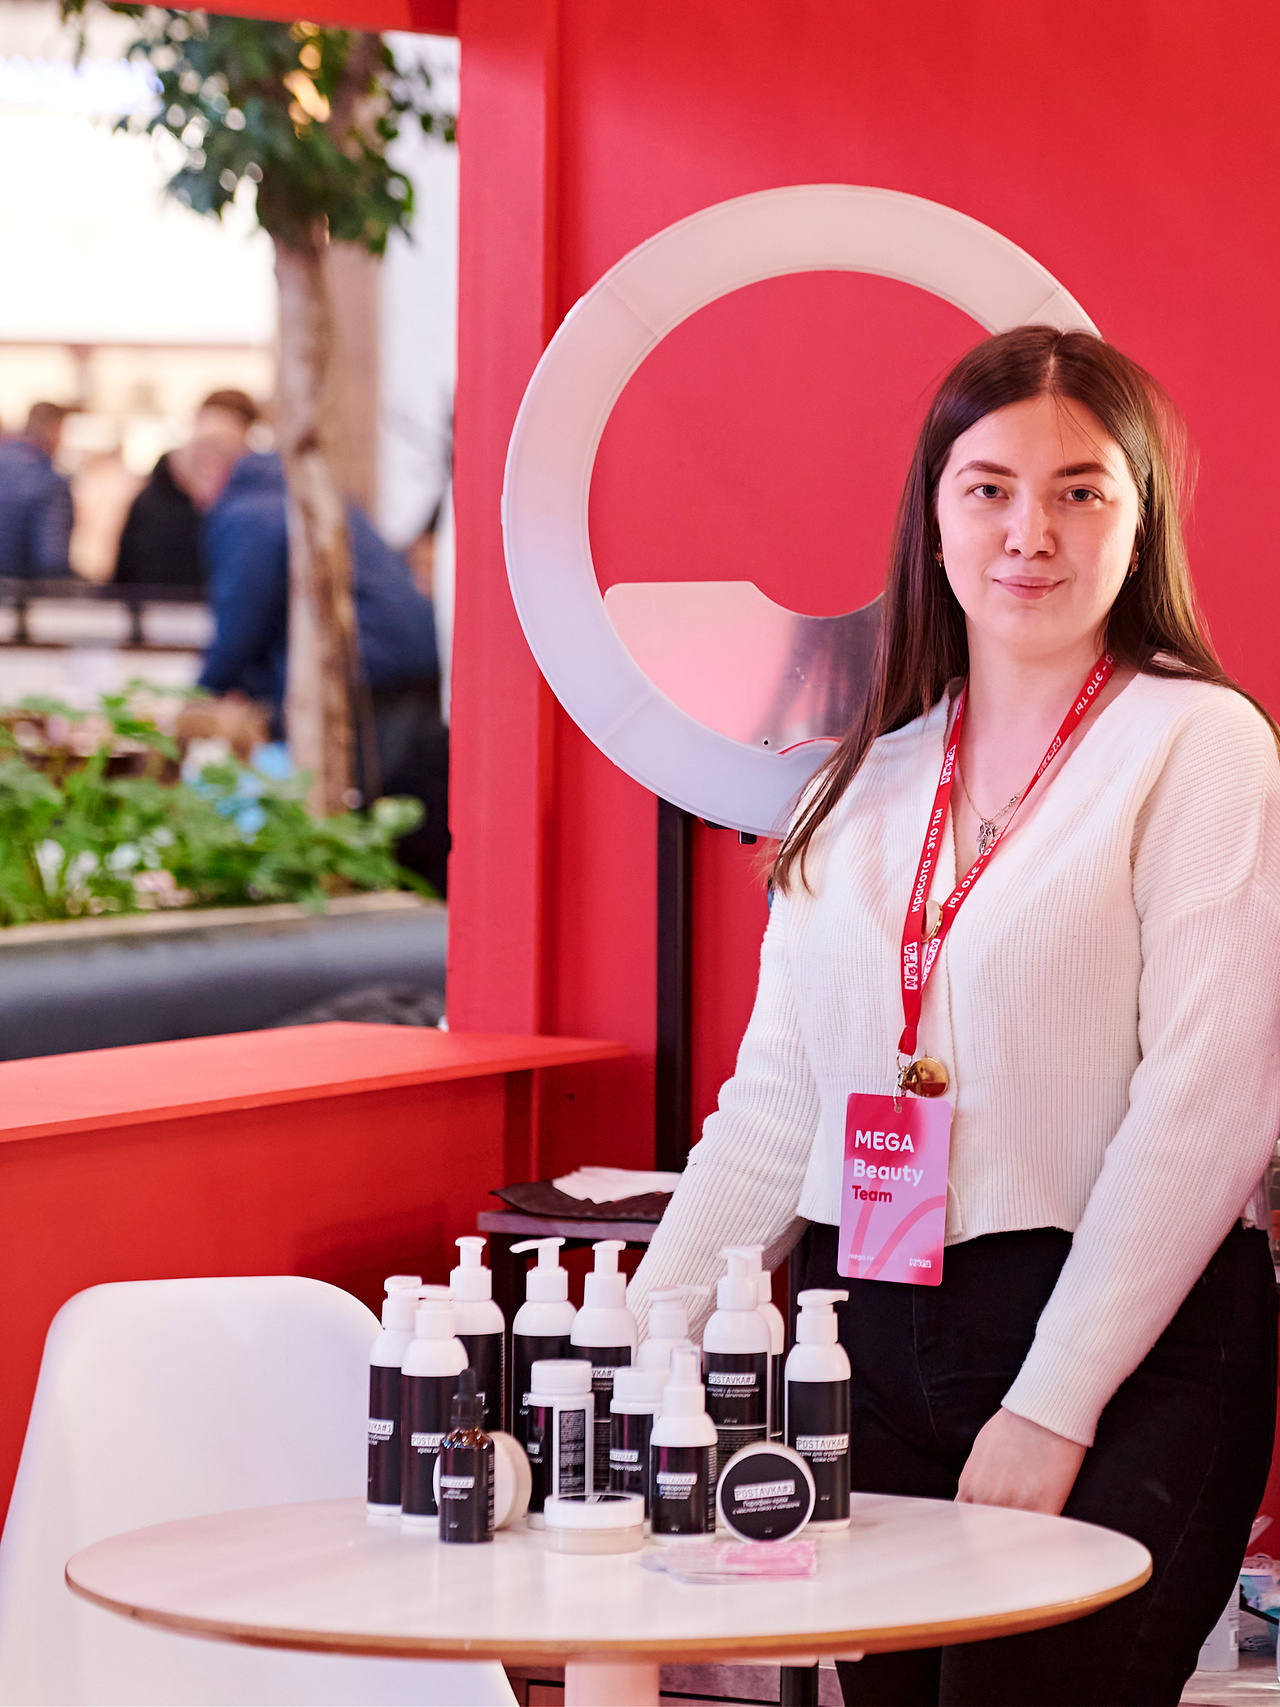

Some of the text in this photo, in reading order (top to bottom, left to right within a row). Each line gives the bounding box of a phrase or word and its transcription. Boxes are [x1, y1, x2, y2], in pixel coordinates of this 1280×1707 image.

[1087, 672, 1104, 695] это
[1075, 696, 1089, 715] ты
[932, 808, 943, 827] ты
[927, 828, 939, 850] это
[911, 860, 931, 913] красота
[961, 866, 980, 888] это
[947, 891, 964, 908] ты
[855, 1130, 914, 1153] MEGA
[853, 1159, 924, 1187] Beauty
[851, 1185, 892, 1203] Team
[709, 1373, 756, 1385] POSTAVKA#1
[411, 1434, 442, 1446] POSTAV
[735, 1482, 795, 1500] POSTAVKA#1
